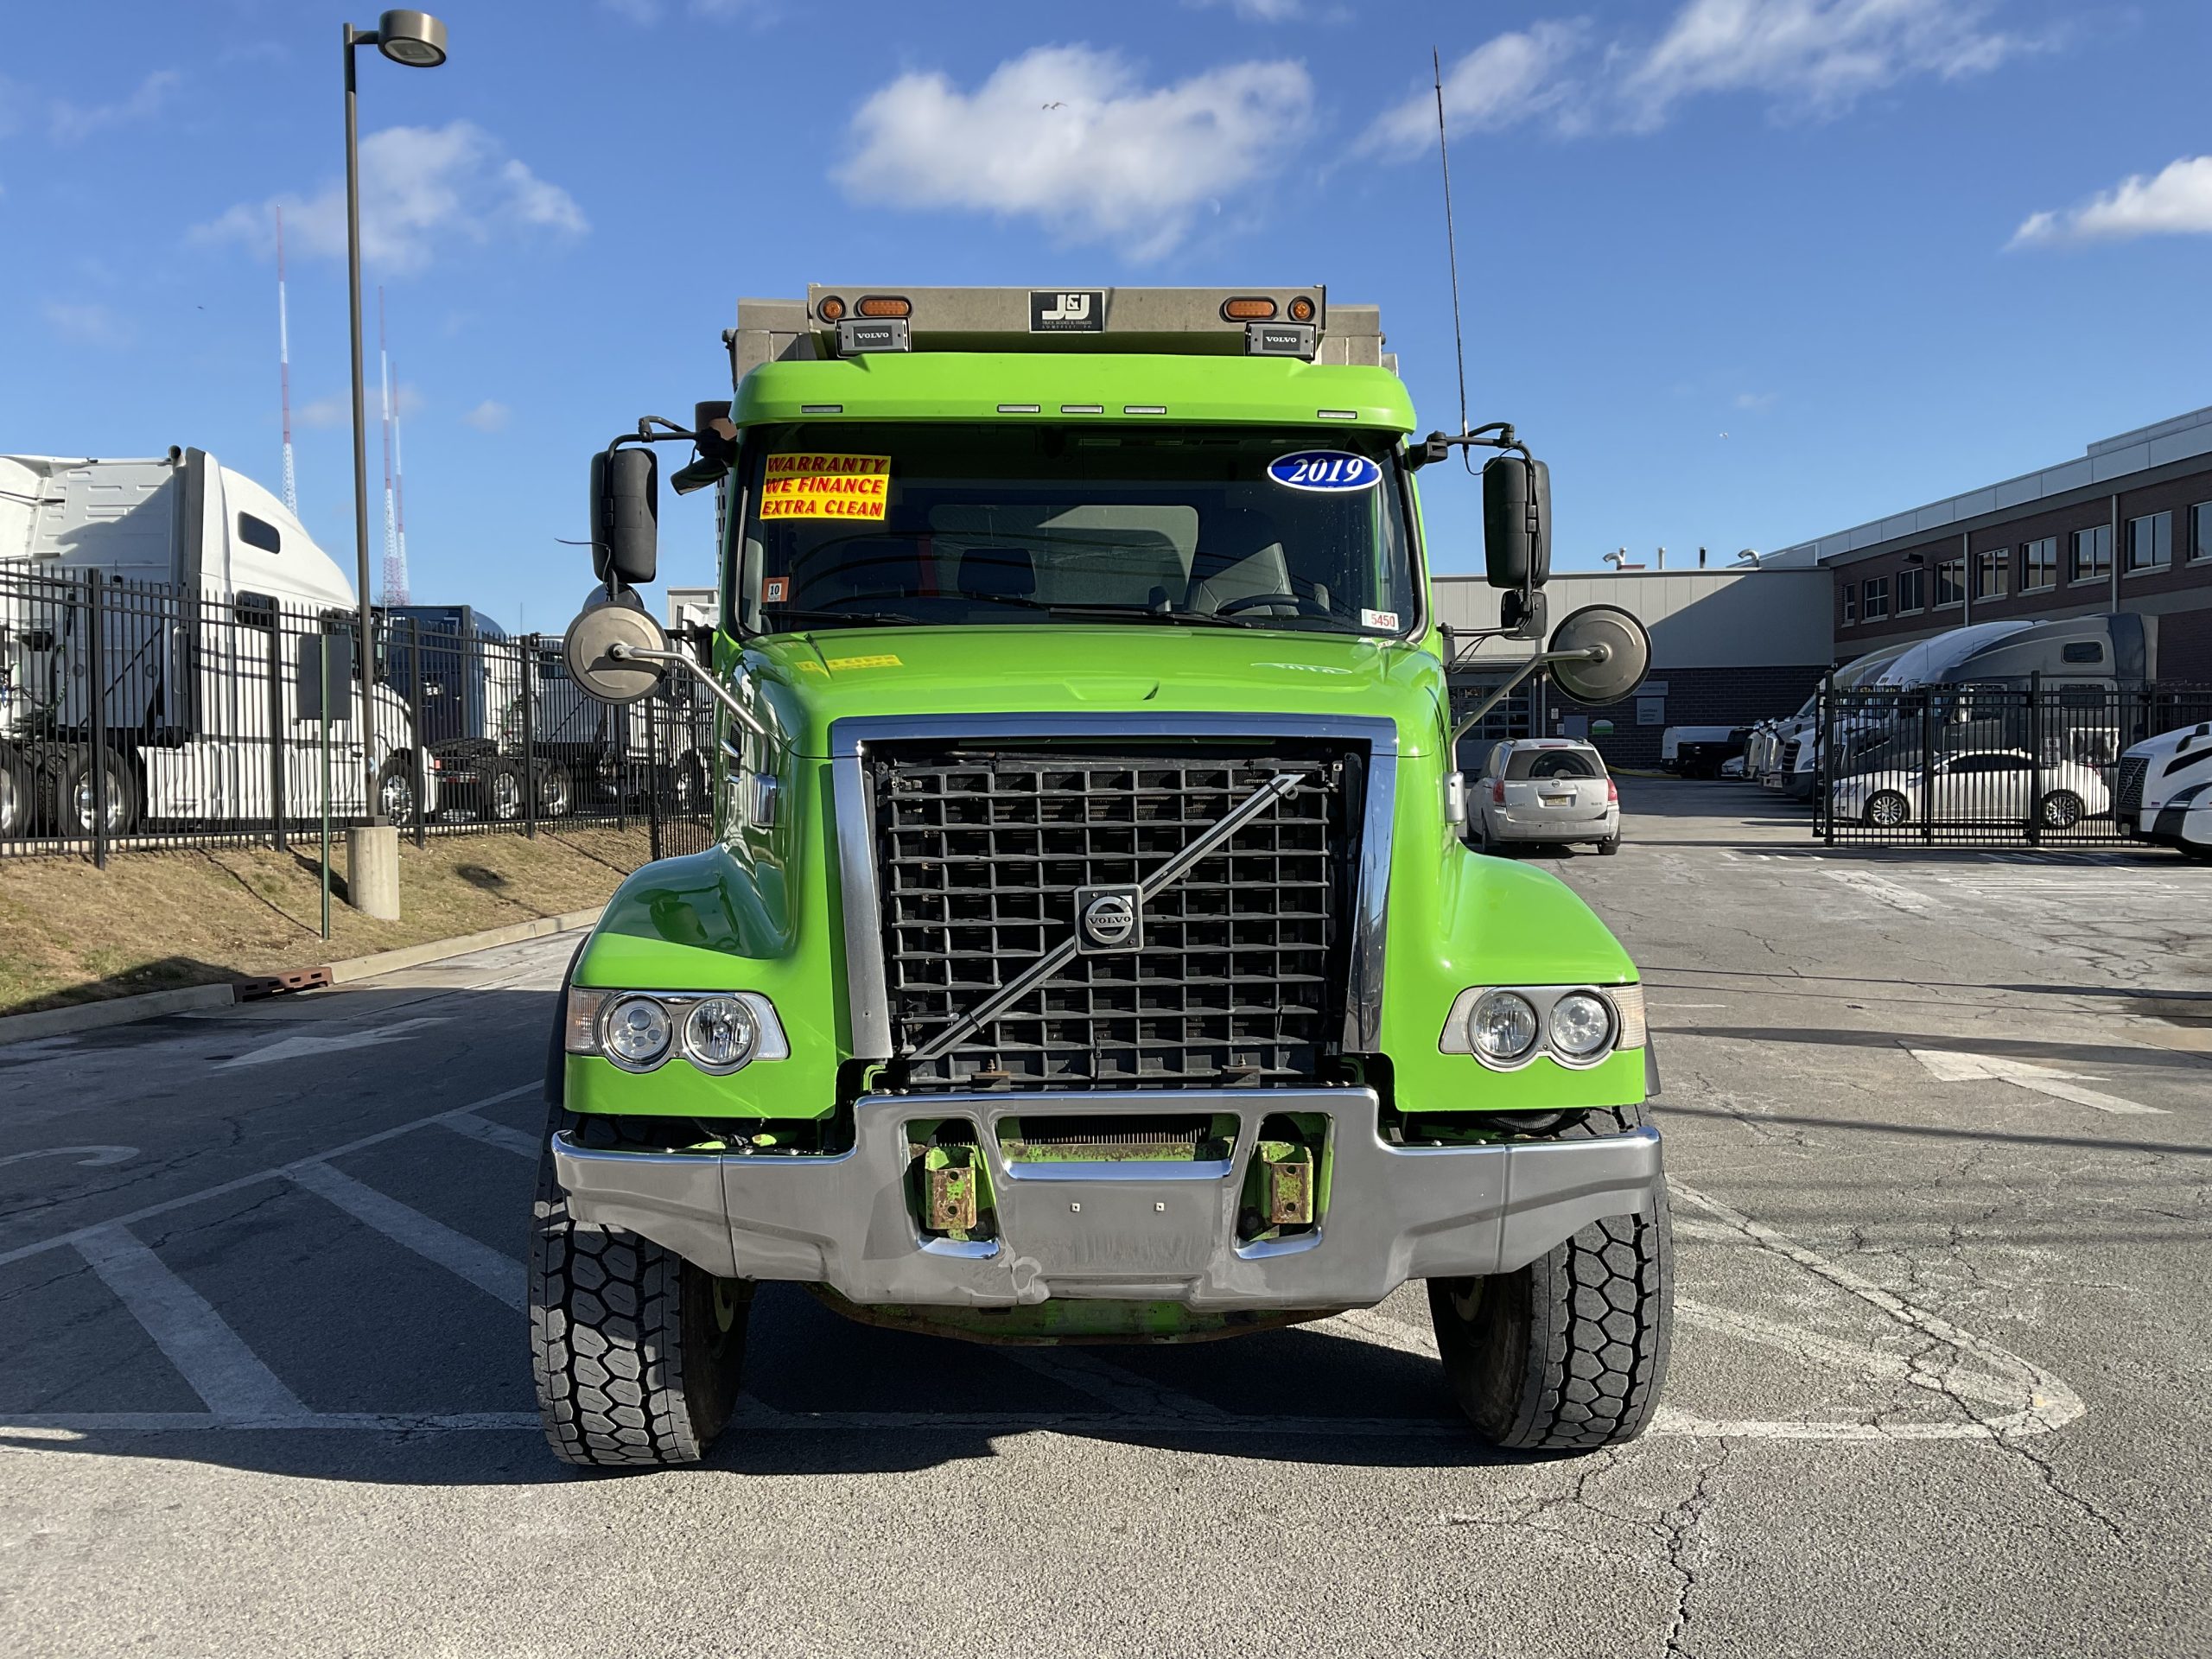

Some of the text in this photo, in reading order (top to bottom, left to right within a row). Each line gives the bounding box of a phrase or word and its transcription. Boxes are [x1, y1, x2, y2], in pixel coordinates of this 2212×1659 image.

[1042, 294, 1090, 320] J&J
[767, 456, 887, 474] WARRANTY
[1287, 458, 1363, 481] 2019
[766, 476, 883, 494] WE FINANCE
[762, 499, 883, 517] EXTRA CLEAN
[770, 585, 780, 595] 10
[1371, 613, 1395, 627] 5450
[1088, 916, 1131, 925] VOLVO
